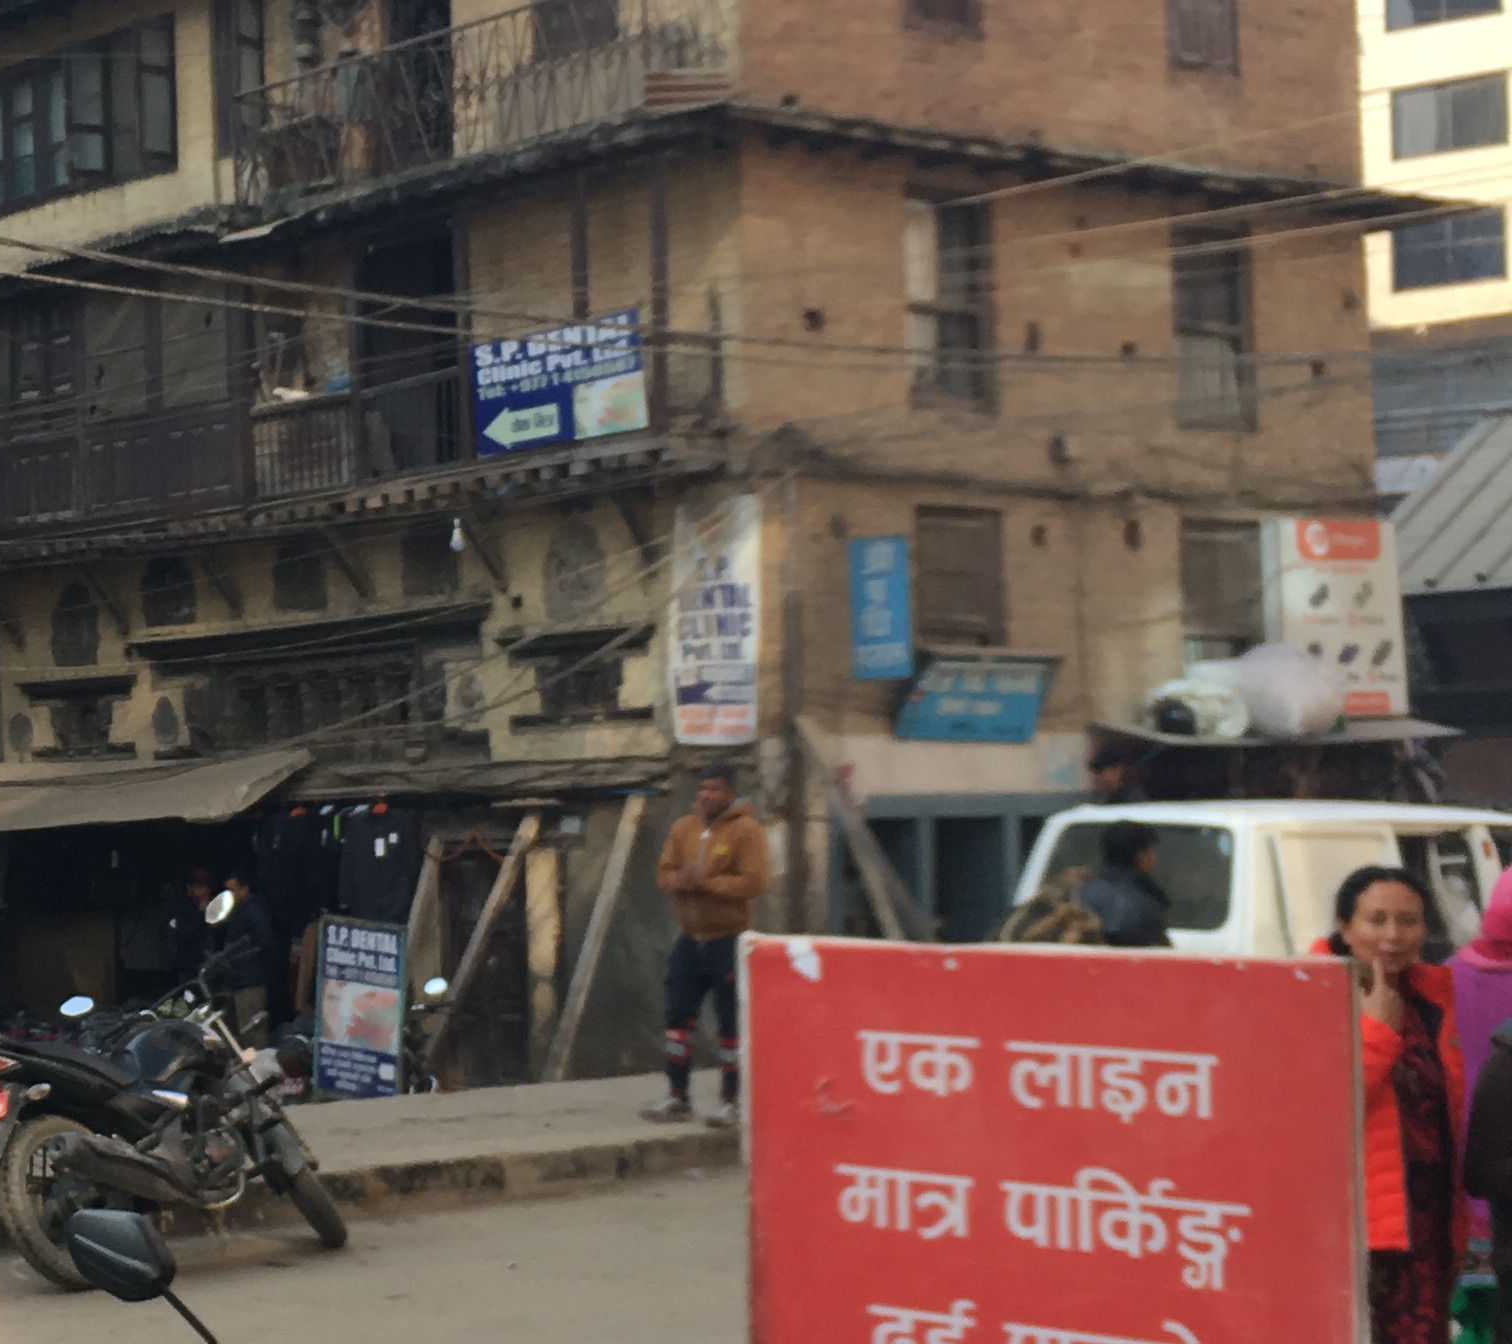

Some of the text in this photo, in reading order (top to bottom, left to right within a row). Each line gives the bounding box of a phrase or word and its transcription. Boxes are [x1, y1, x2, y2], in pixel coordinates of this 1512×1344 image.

[475, 340, 523, 367] S.P.
[477, 360, 542, 385] Clinic
[857, 1030, 1219, 1125] एक लाइन
[834, 1164, 974, 1240] मात्र
